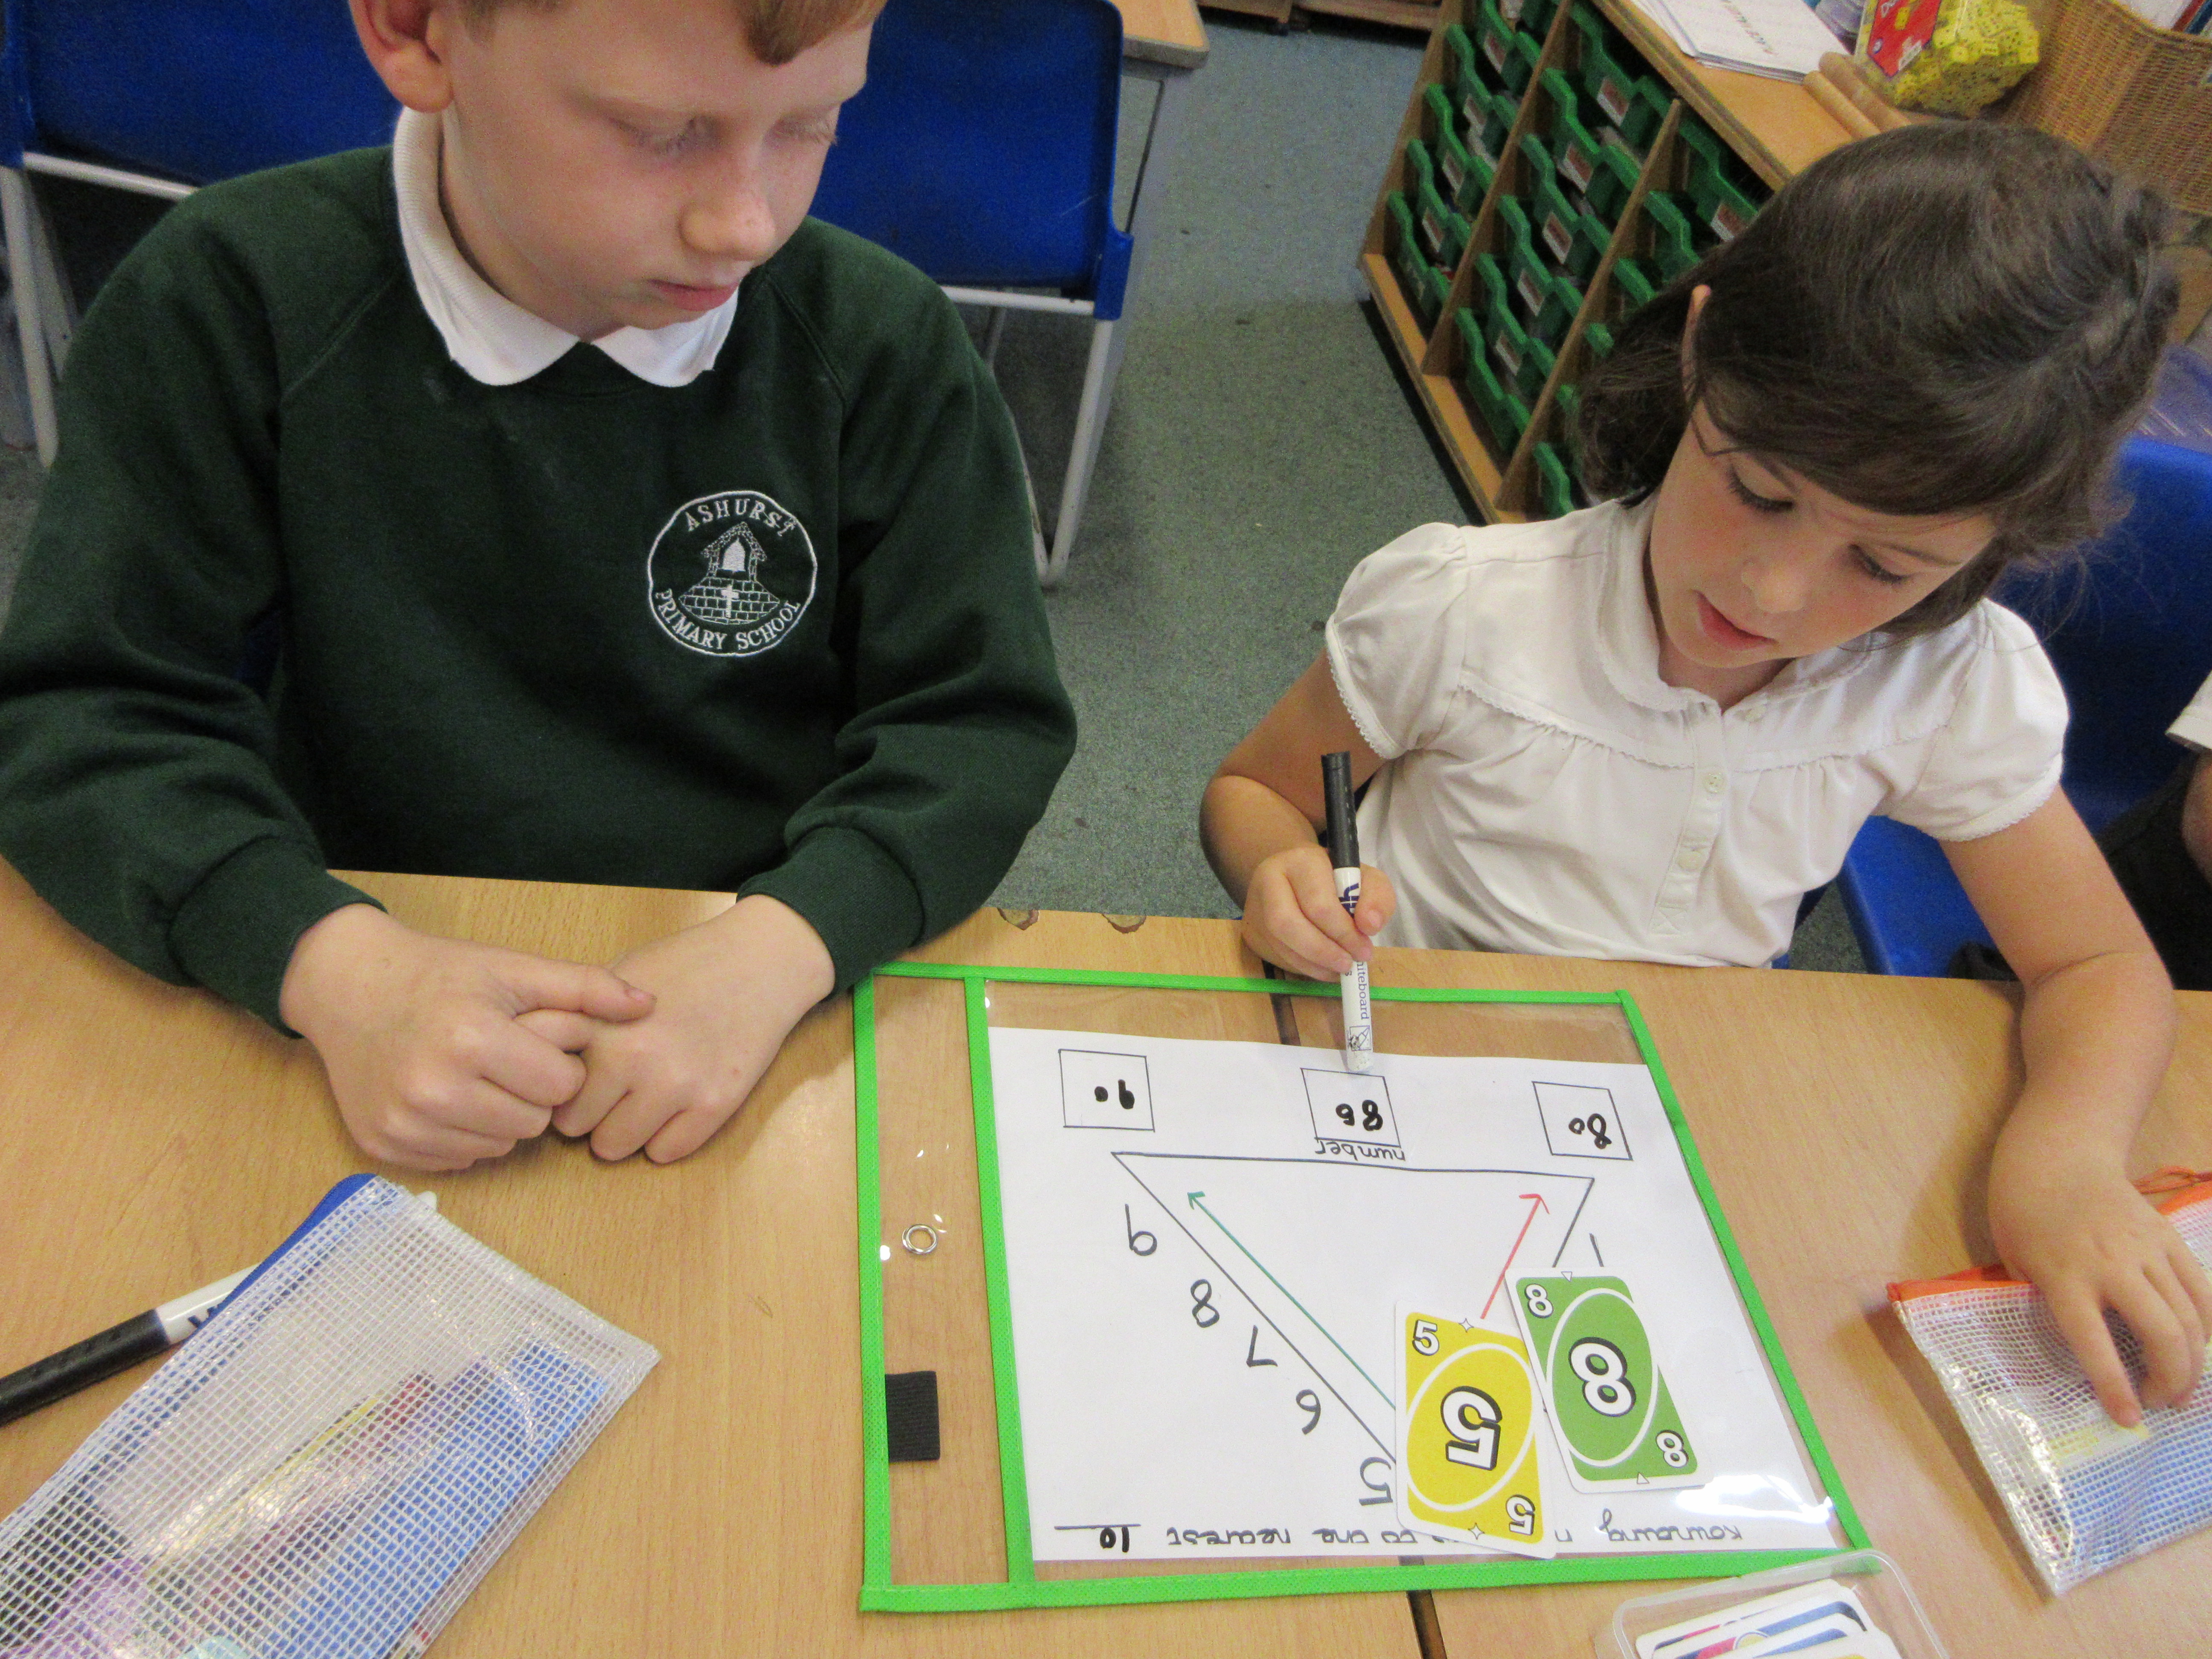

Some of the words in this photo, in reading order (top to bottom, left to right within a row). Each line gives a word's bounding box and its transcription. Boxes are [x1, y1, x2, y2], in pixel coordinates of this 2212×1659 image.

[685, 498, 797, 536] ASHURST
[655, 588, 728, 649] PRIMARY
[736, 600, 800, 650] SCHOOL
[1315, 1140, 1406, 1161] number
[1568, 1113, 1612, 1150] 80
[1125, 1204, 1157, 1256] 9
[1190, 1279, 1220, 1328] 8
[1524, 1283, 1554, 1318] 8
[1246, 1325, 1278, 1368] 7
[1412, 1319, 1440, 1356] 5
[1568, 1336, 1637, 1417] 8
[1295, 1389, 1321, 1435] 6
[1440, 1385, 1503, 1471] 5
[1655, 1429, 1689, 1468] 8
[1359, 1456, 1394, 1506] 5
[1166, 1526, 1291, 1545] nearest
[1505, 1494, 1536, 1536] 5
[1100, 1526, 1130, 1553] 10
